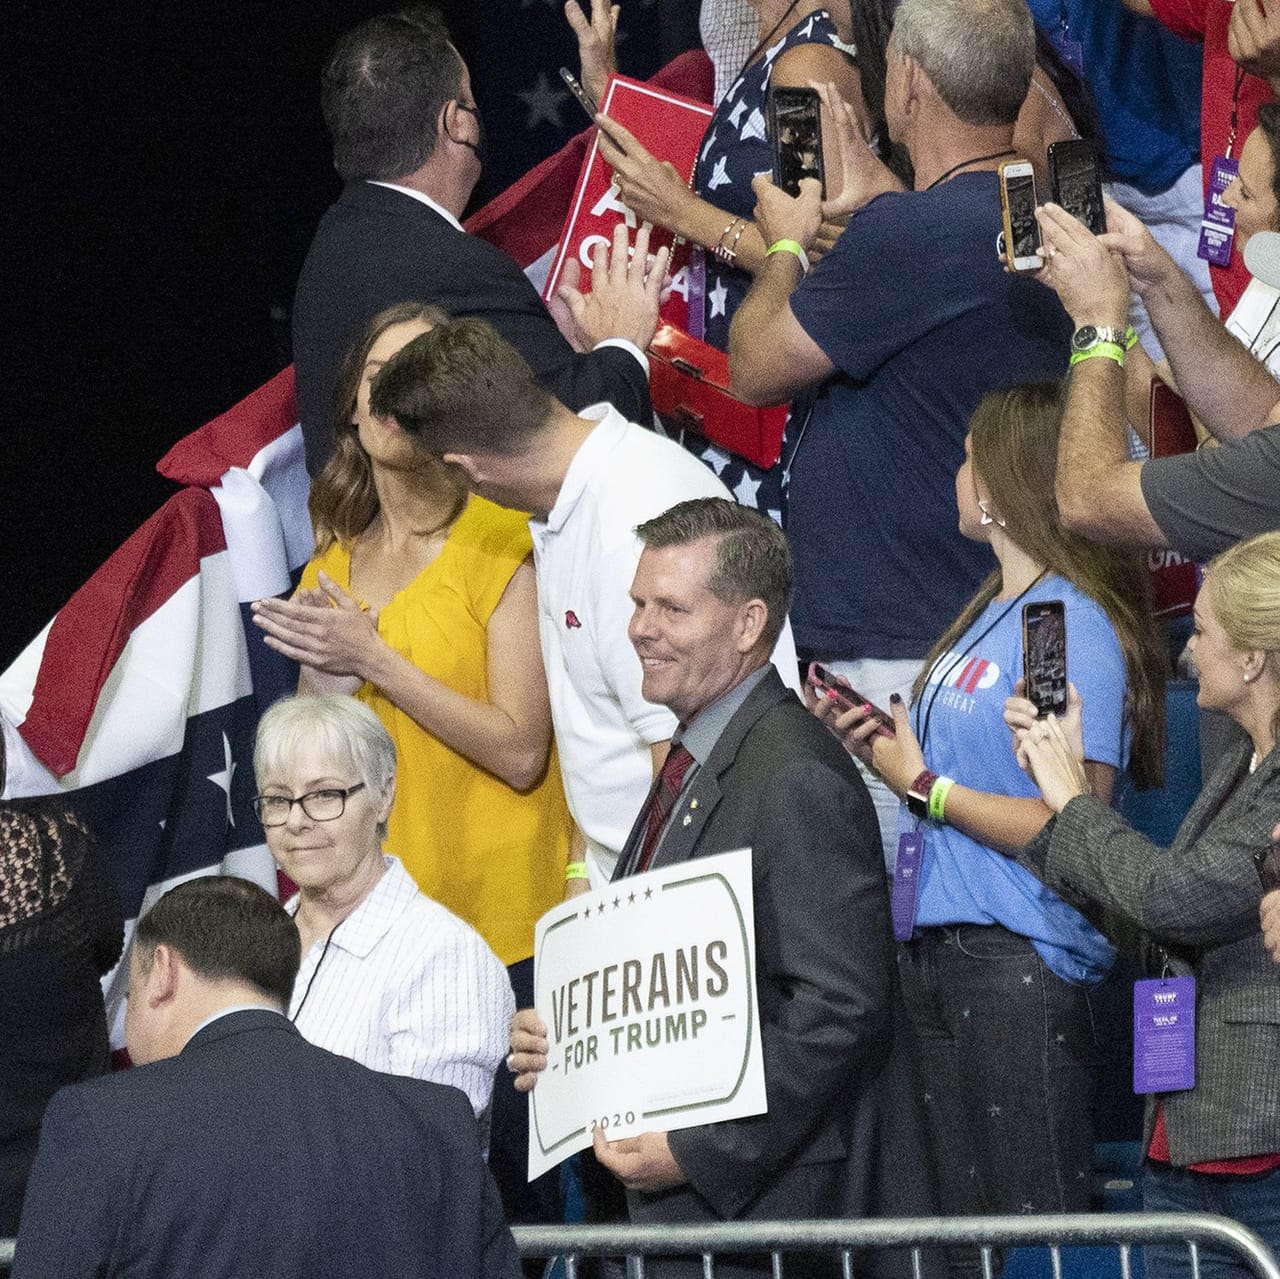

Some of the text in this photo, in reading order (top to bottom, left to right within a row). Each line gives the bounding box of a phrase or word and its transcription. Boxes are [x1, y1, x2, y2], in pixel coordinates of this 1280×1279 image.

[551, 940, 730, 1044] VETERANS
[564, 1008, 708, 1076] FOR TRUMP
[590, 1111, 635, 1133] 2020
